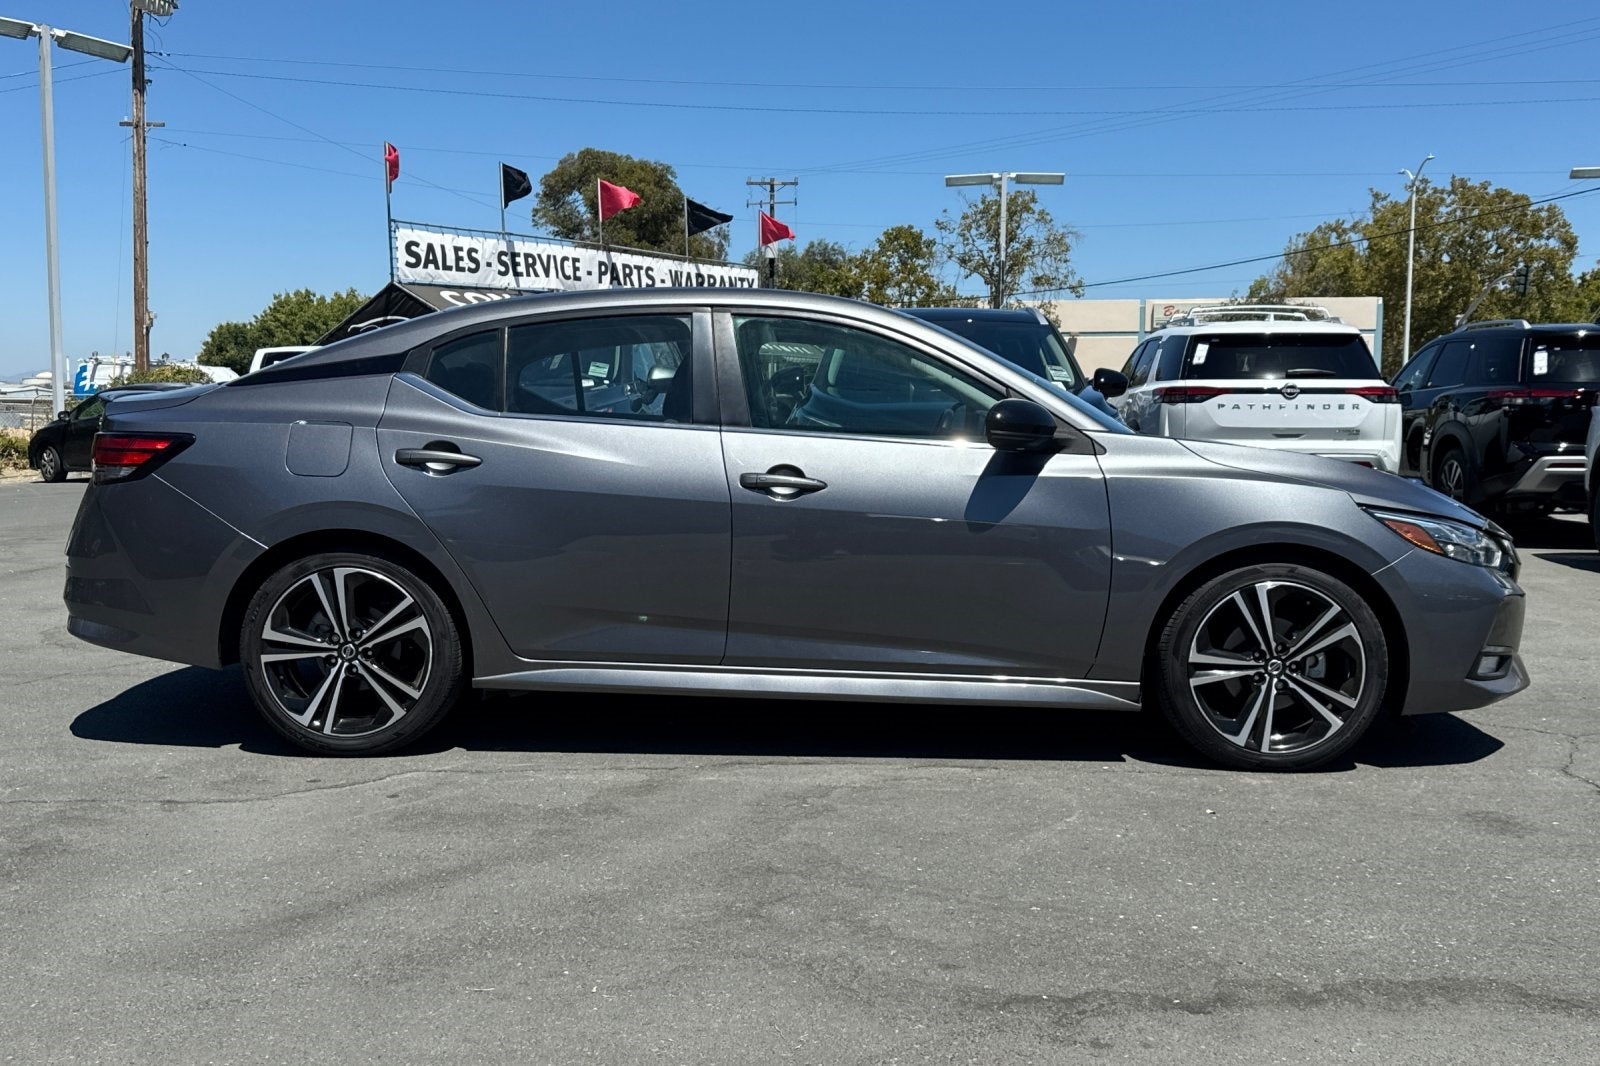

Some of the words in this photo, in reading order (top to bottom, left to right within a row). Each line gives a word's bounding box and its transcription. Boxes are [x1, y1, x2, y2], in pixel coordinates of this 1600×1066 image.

[404, 240, 481, 274] SALES
[497, 250, 582, 282] SERVICE
[598, 260, 656, 288] PARTS
[1217, 403, 1361, 411] PATHFINDER
